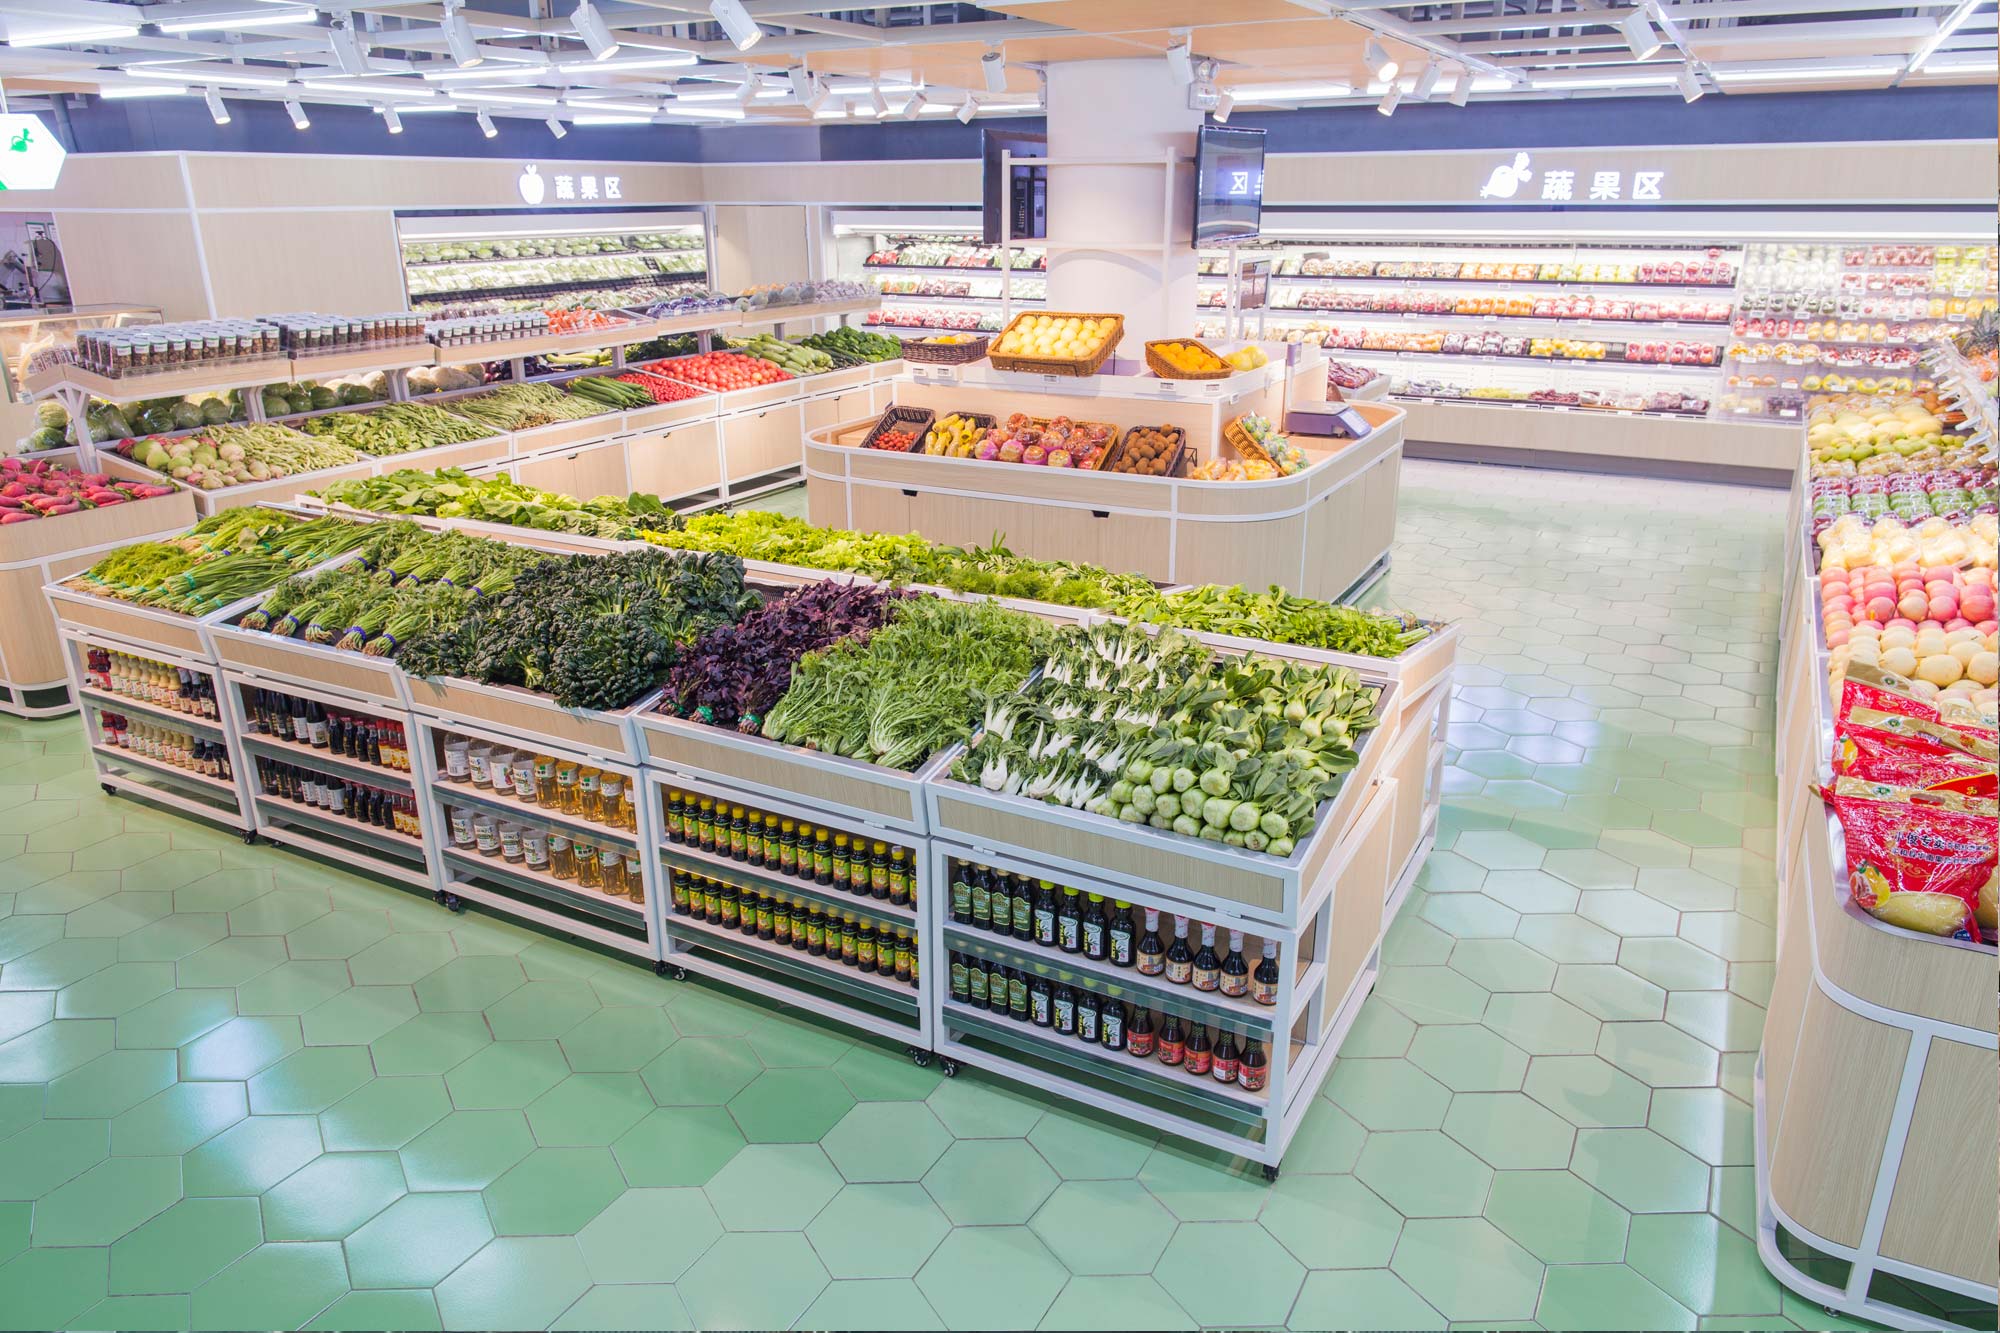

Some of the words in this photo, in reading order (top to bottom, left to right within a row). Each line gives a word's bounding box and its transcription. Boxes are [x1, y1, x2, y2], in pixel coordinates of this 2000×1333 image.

[554, 175, 622, 200] 蔬果区
[1541, 169, 1665, 201] 蔬果区
